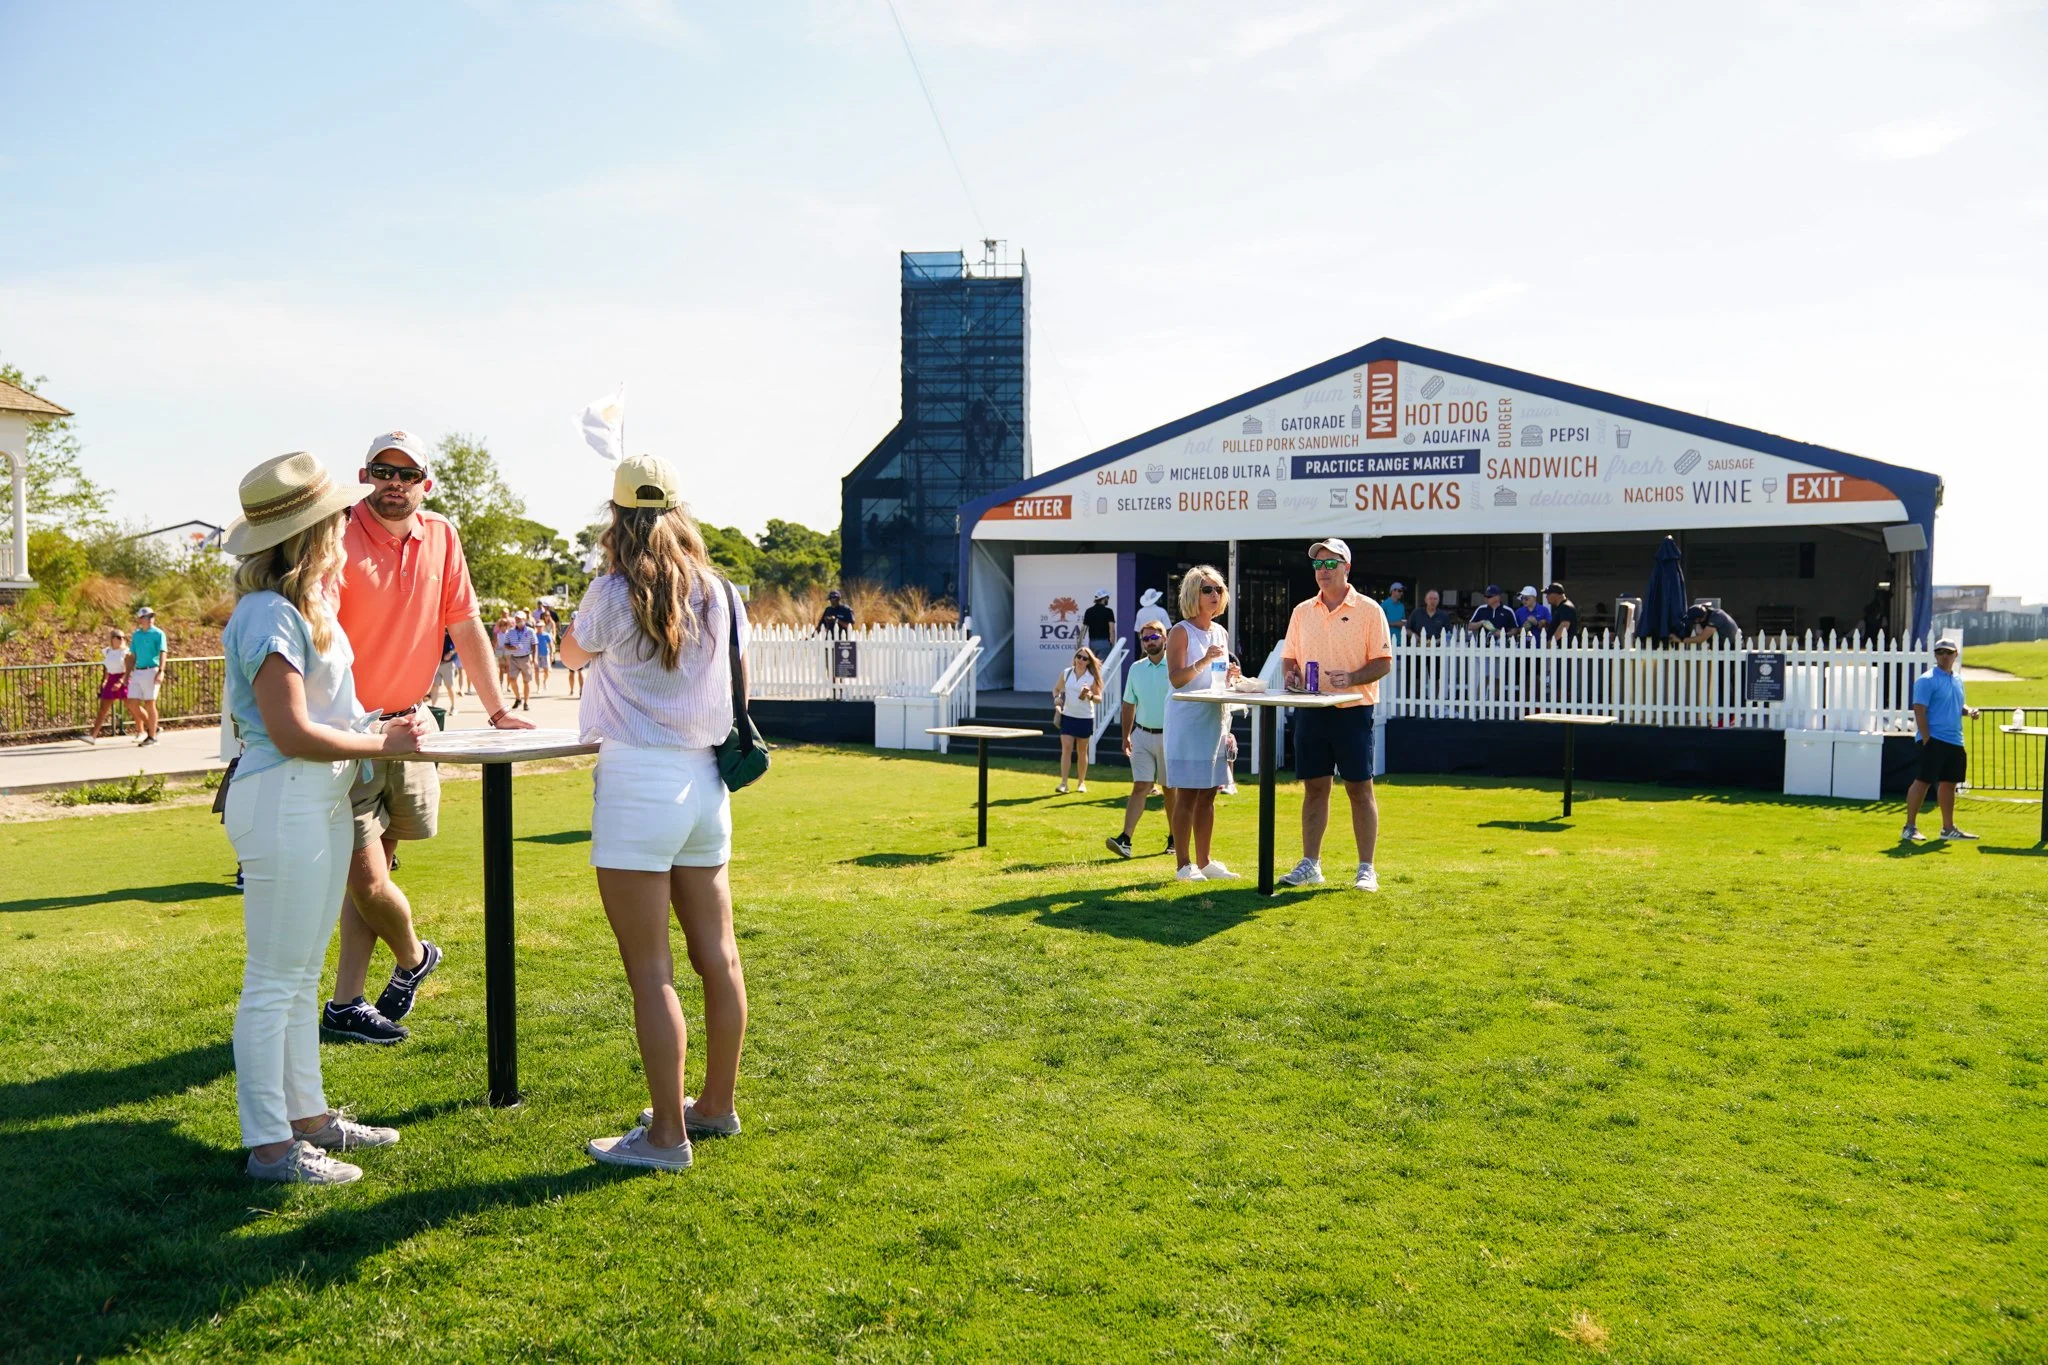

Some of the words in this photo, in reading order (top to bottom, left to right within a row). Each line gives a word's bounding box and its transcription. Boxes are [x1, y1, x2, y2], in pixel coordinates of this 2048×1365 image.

[1353, 372, 1362, 399] SALAD
[1302, 389, 1346, 410] yum
[1371, 373, 1393, 432] MENU
[1405, 403, 1442, 426] HOT
[1448, 401, 1488, 424] DOG
[1281, 415, 1345, 431] GATORADE
[1498, 398, 1512, 448] BURGER
[1223, 440, 1263, 453] PULLED
[1266, 438, 1296, 451] PORK
[1298, 434, 1359, 450] SANDWICH
[1423, 428, 1490, 444] AQUAFINA
[1550, 427, 1589, 442] PEPSI
[1184, 437, 1215, 455] hot
[1170, 466, 1229, 480] MICHELOB
[1232, 464, 1271, 479] ULTRA
[1306, 460, 1364, 473] PRACTICE
[1368, 458, 1409, 471] RANGE
[1413, 456, 1464, 469] MARKET
[1486, 455, 1598, 480] SANDWICH
[1602, 454, 1666, 483] fresh
[1707, 458, 1755, 470] SAUSAGE
[1097, 470, 1138, 485] SALAD
[1354, 481, 1461, 511] SNACKS
[1529, 489, 1613, 506] delicious
[1624, 486, 1684, 503] NACHOS
[1692, 479, 1753, 504] WINE
[1793, 477, 1843, 500] EXIT
[1014, 499, 1063, 517] ENTER
[1117, 496, 1172, 511] SELTZERS
[1178, 490, 1249, 511] BURGER
[1283, 495, 1318, 511] enjoy
[1040, 624, 1081, 639] PGA
